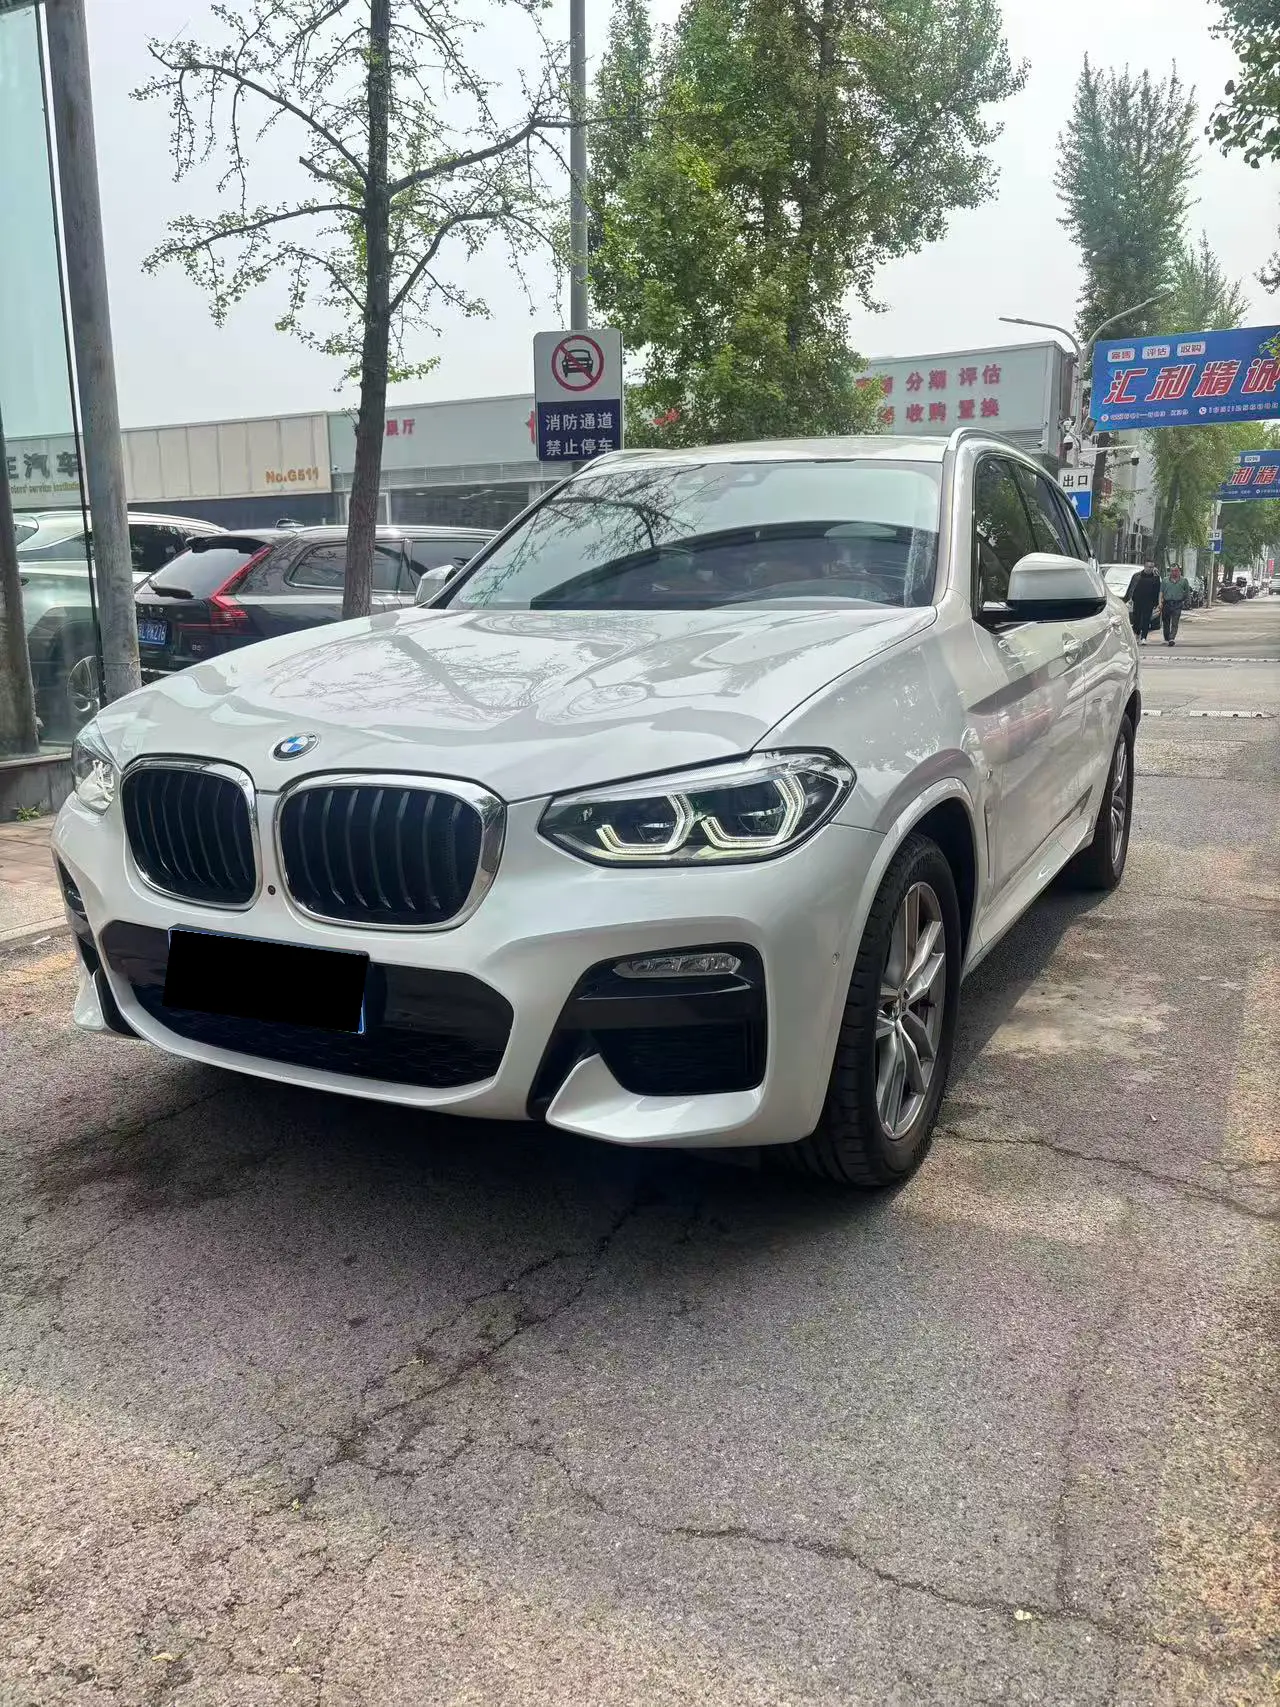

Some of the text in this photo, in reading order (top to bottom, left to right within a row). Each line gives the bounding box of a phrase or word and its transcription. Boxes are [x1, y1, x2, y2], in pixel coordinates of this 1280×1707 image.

[1147, 348, 1167, 357] 评估
[1181, 344, 1202, 353] 收购
[905, 370, 948, 392] 分期
[958, 363, 1002, 387] 评估
[1102, 358, 1280, 405] 汇利精诚
[545, 412, 613, 431] 消防通道
[905, 402, 947, 423] 收购
[546, 438, 614, 456] 禁止停车
[265, 466, 320, 484] No.G511
[1062, 474, 1088, 488] 出口
